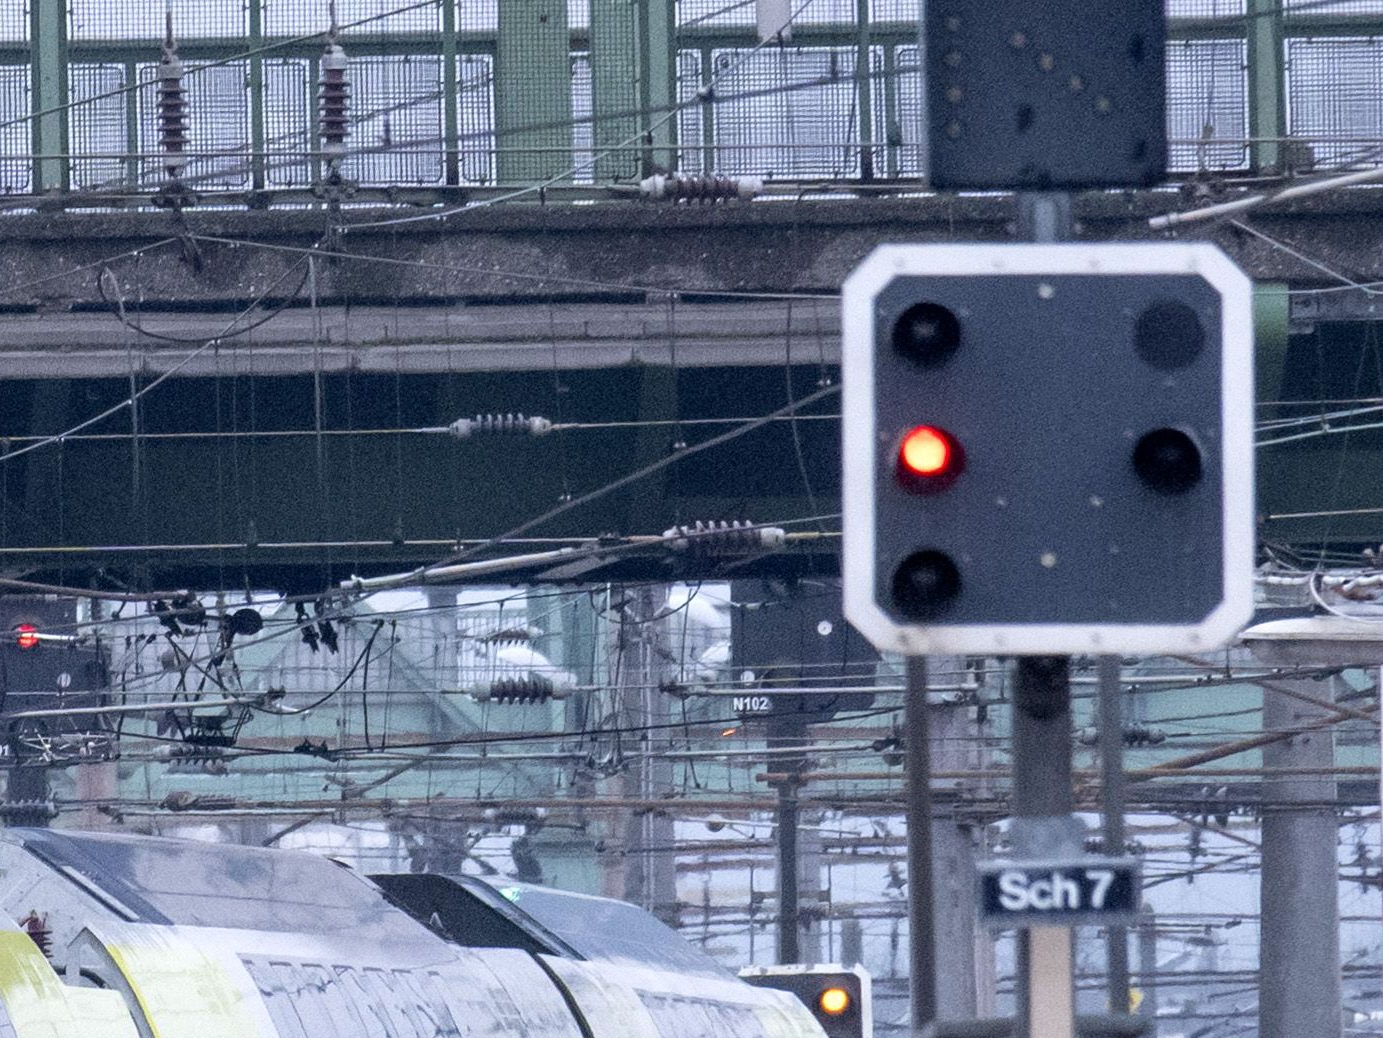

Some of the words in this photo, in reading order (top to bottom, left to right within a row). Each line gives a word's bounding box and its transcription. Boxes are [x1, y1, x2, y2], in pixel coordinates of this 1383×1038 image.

[733, 697, 768, 711] N102
[998, 870, 1079, 911] Sch
[1085, 870, 1114, 909] 7
